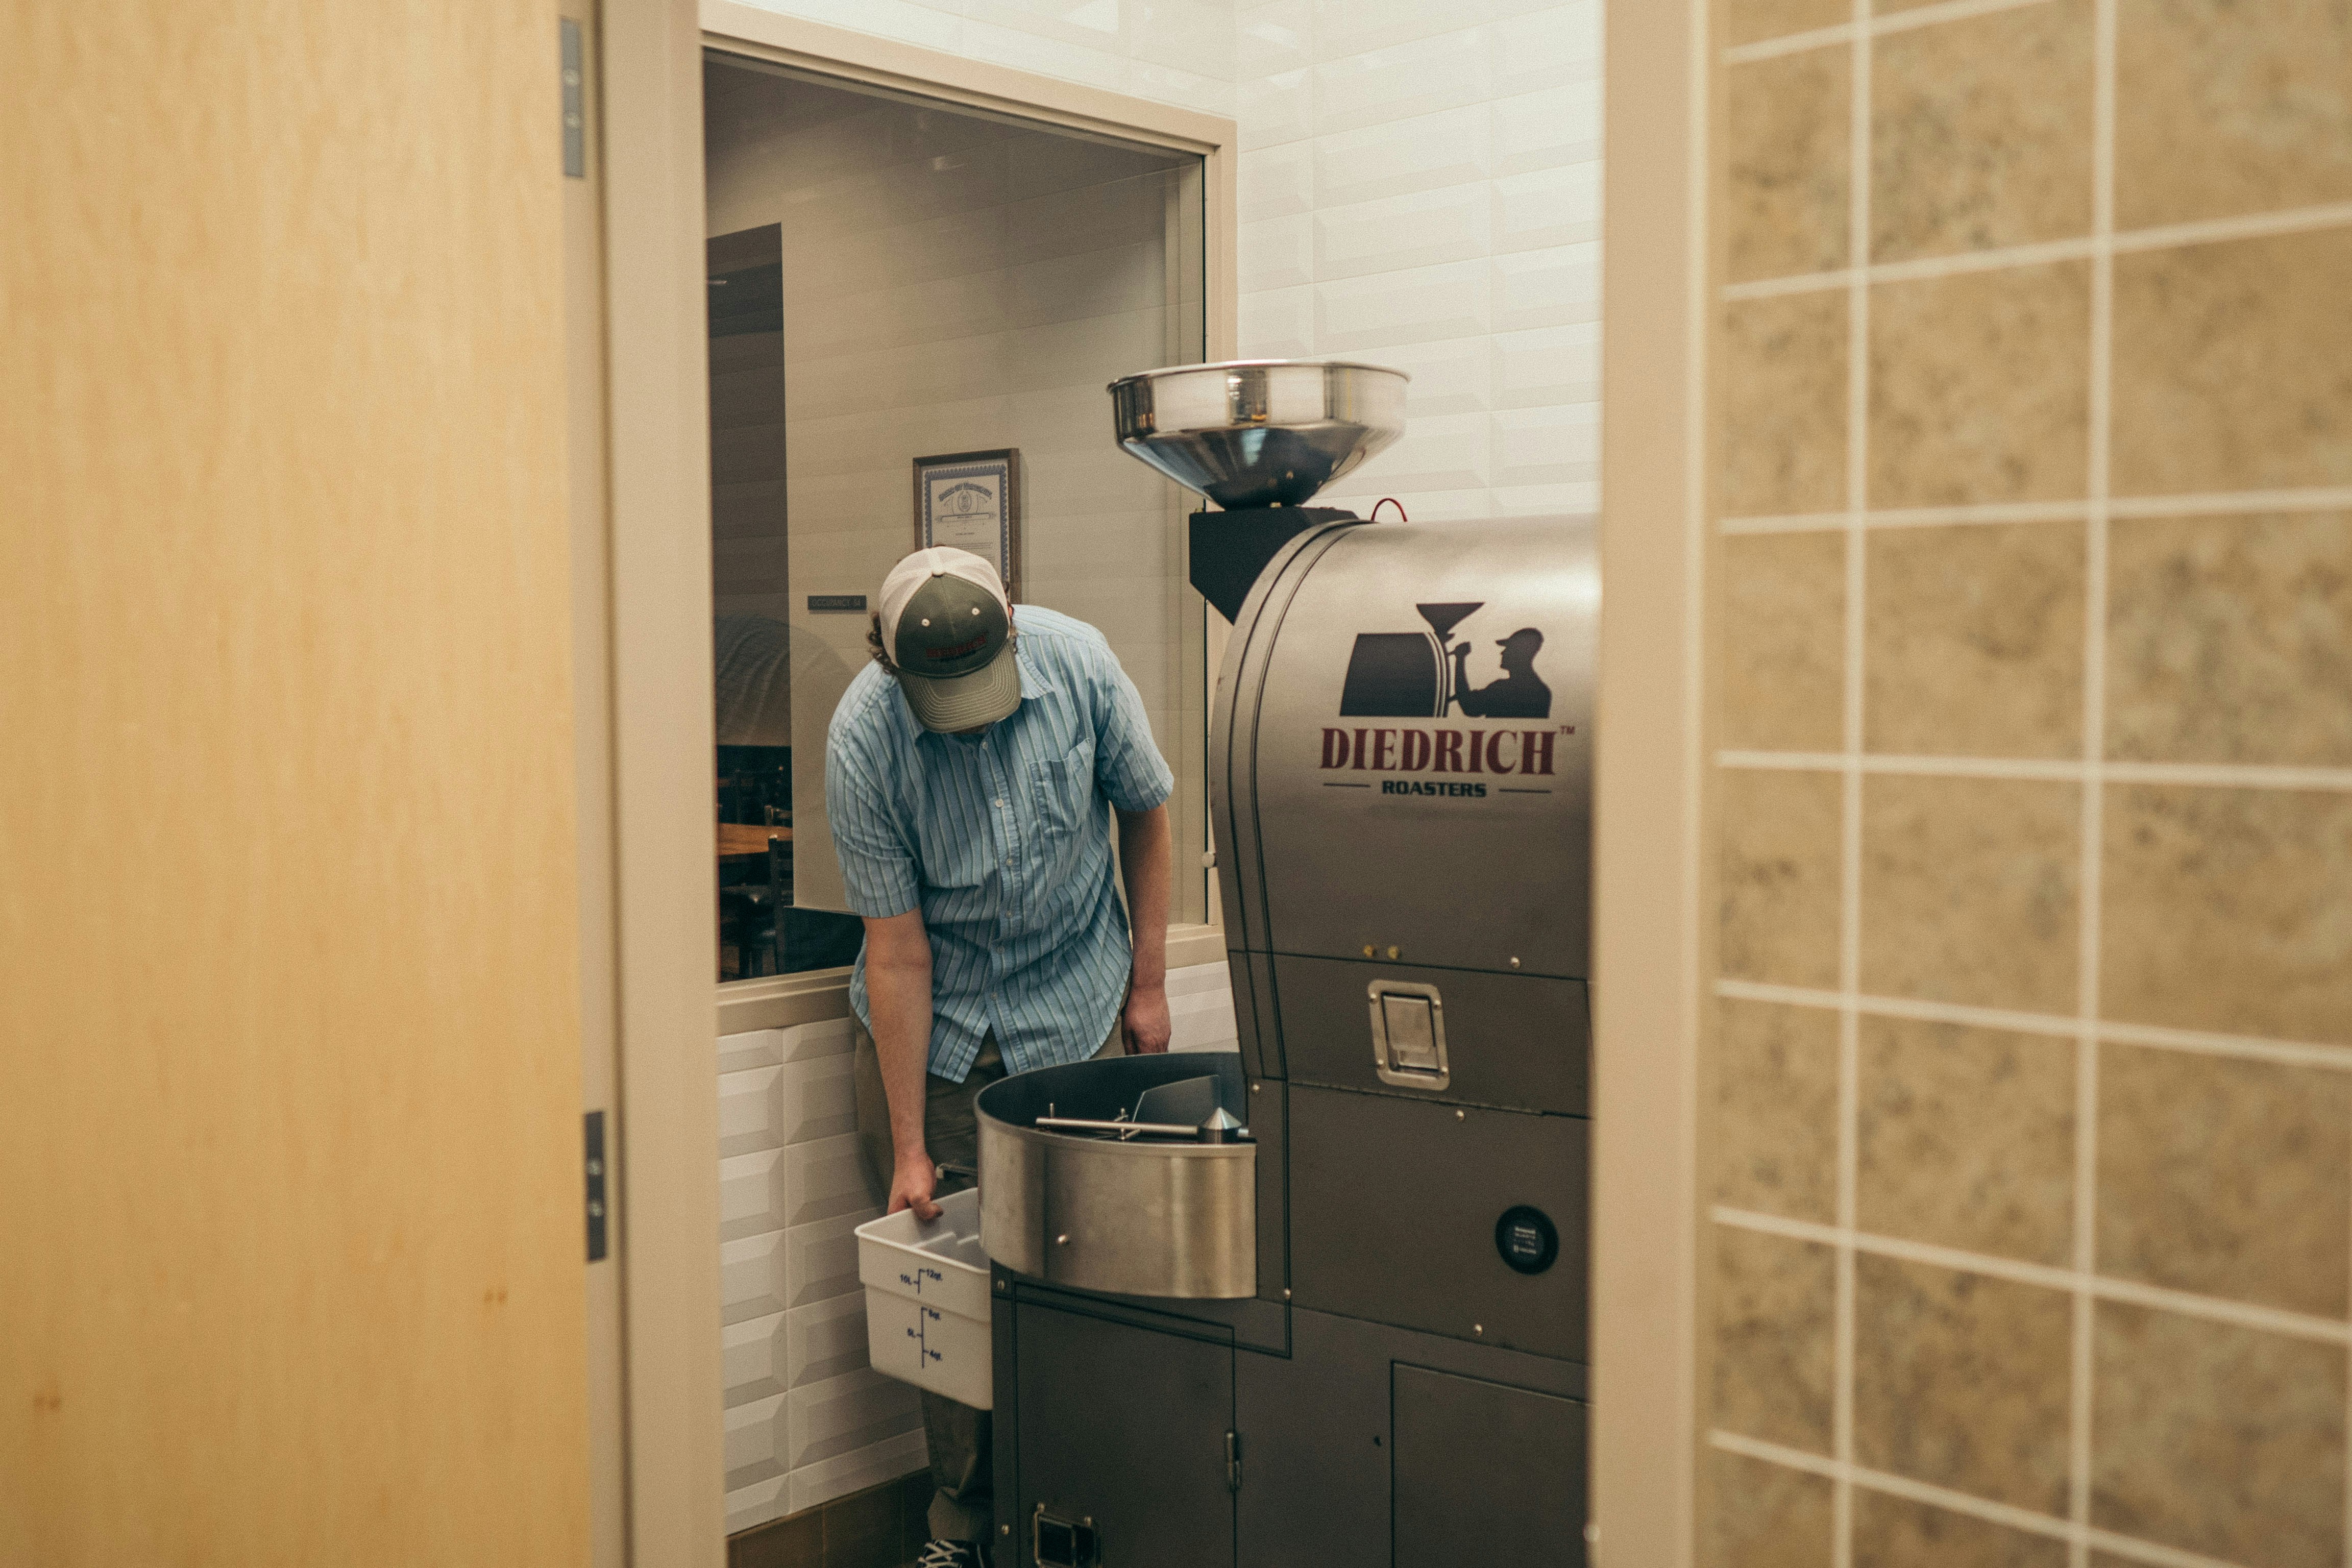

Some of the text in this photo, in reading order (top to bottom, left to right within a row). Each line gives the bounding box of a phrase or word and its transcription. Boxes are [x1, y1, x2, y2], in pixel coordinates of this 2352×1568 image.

[812, 598, 851, 607] OCCUPANCY
[1320, 728, 1555, 775] DIEDRICH
[1382, 780, 1487, 798] ROASTERS
